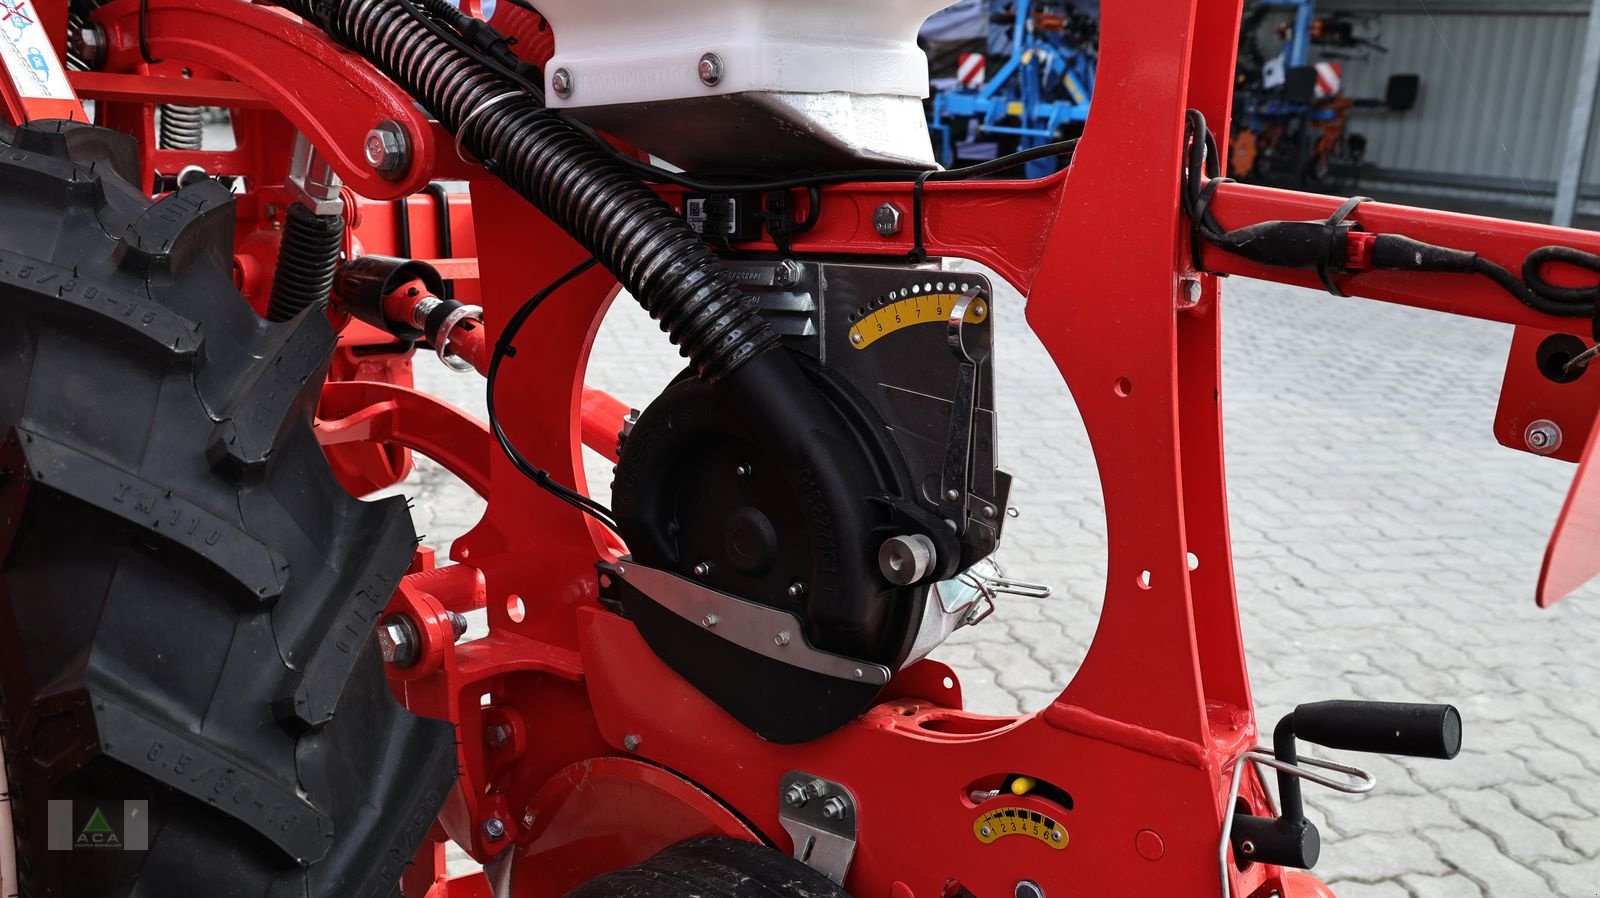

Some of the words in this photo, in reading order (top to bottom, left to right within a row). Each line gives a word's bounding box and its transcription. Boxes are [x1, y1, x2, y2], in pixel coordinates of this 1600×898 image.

[0, 258, 158, 324] .5/80-15
[878, 323, 883, 331] 3
[895, 315, 901, 324] 5
[916, 309, 921, 318] 7
[937, 306, 942, 315] 9
[112, 483, 221, 546] IM110
[1001, 824, 1007, 833] 2
[1011, 822, 1017, 831] 3
[1022, 823, 1027, 832] 4
[1033, 826, 1038, 834] 5
[1044, 831, 1049, 839] 6
